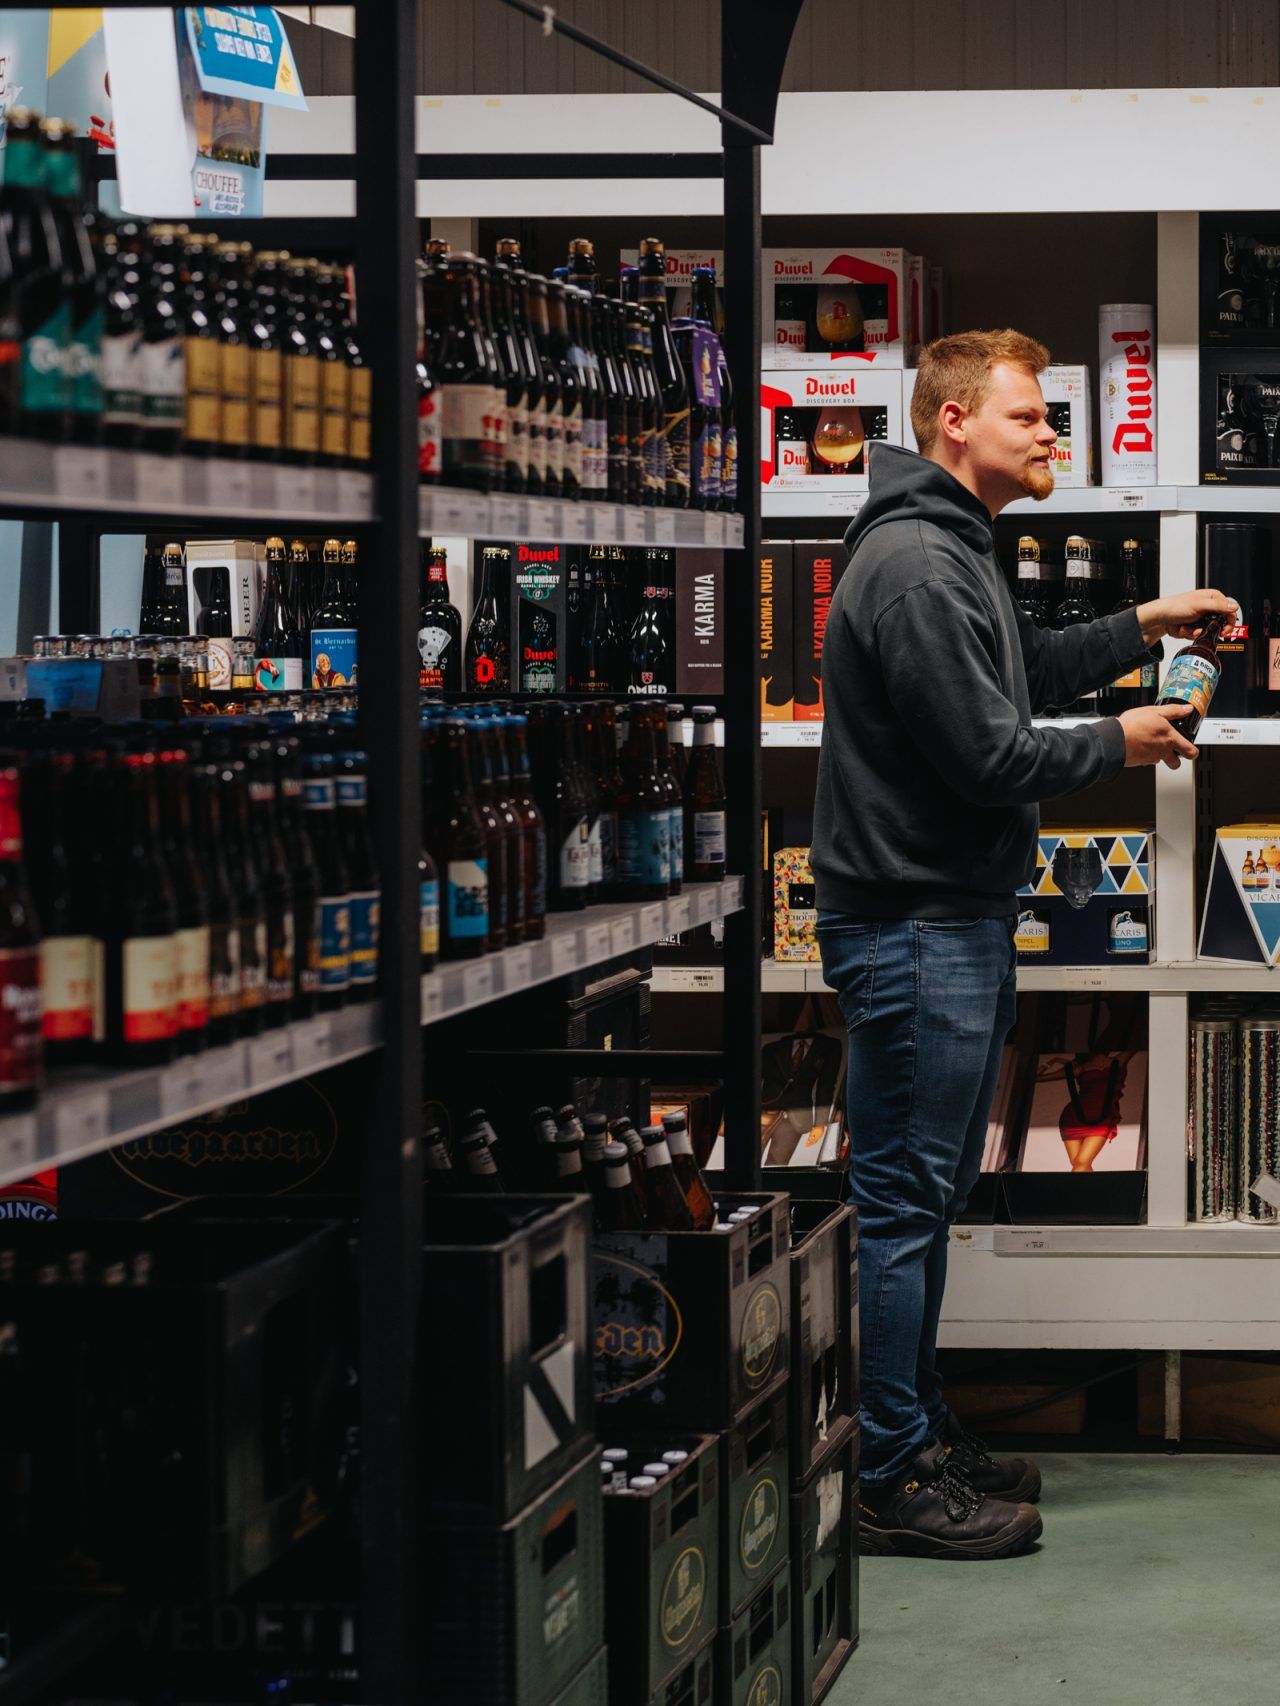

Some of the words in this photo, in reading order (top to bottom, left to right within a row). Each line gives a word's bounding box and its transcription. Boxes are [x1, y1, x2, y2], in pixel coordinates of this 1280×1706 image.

[196, 172, 241, 194] CHOUFFE
[774, 260, 813, 275] Duvel
[776, 328, 807, 345] Duv
[805, 377, 856, 396] Duvel
[1111, 329, 1153, 455] Duvel
[1220, 452, 1238, 462] PAIX
[517, 545, 560, 562] Duvel
[516, 575, 534, 584] IRISH
[814, 558, 833, 593] NOIR
[242, 576, 251, 625] BEER
[694, 574, 715, 637] KARMA
[1017, 928, 1045, 936] CARIS
[1113, 929, 1142, 938] CARIS
